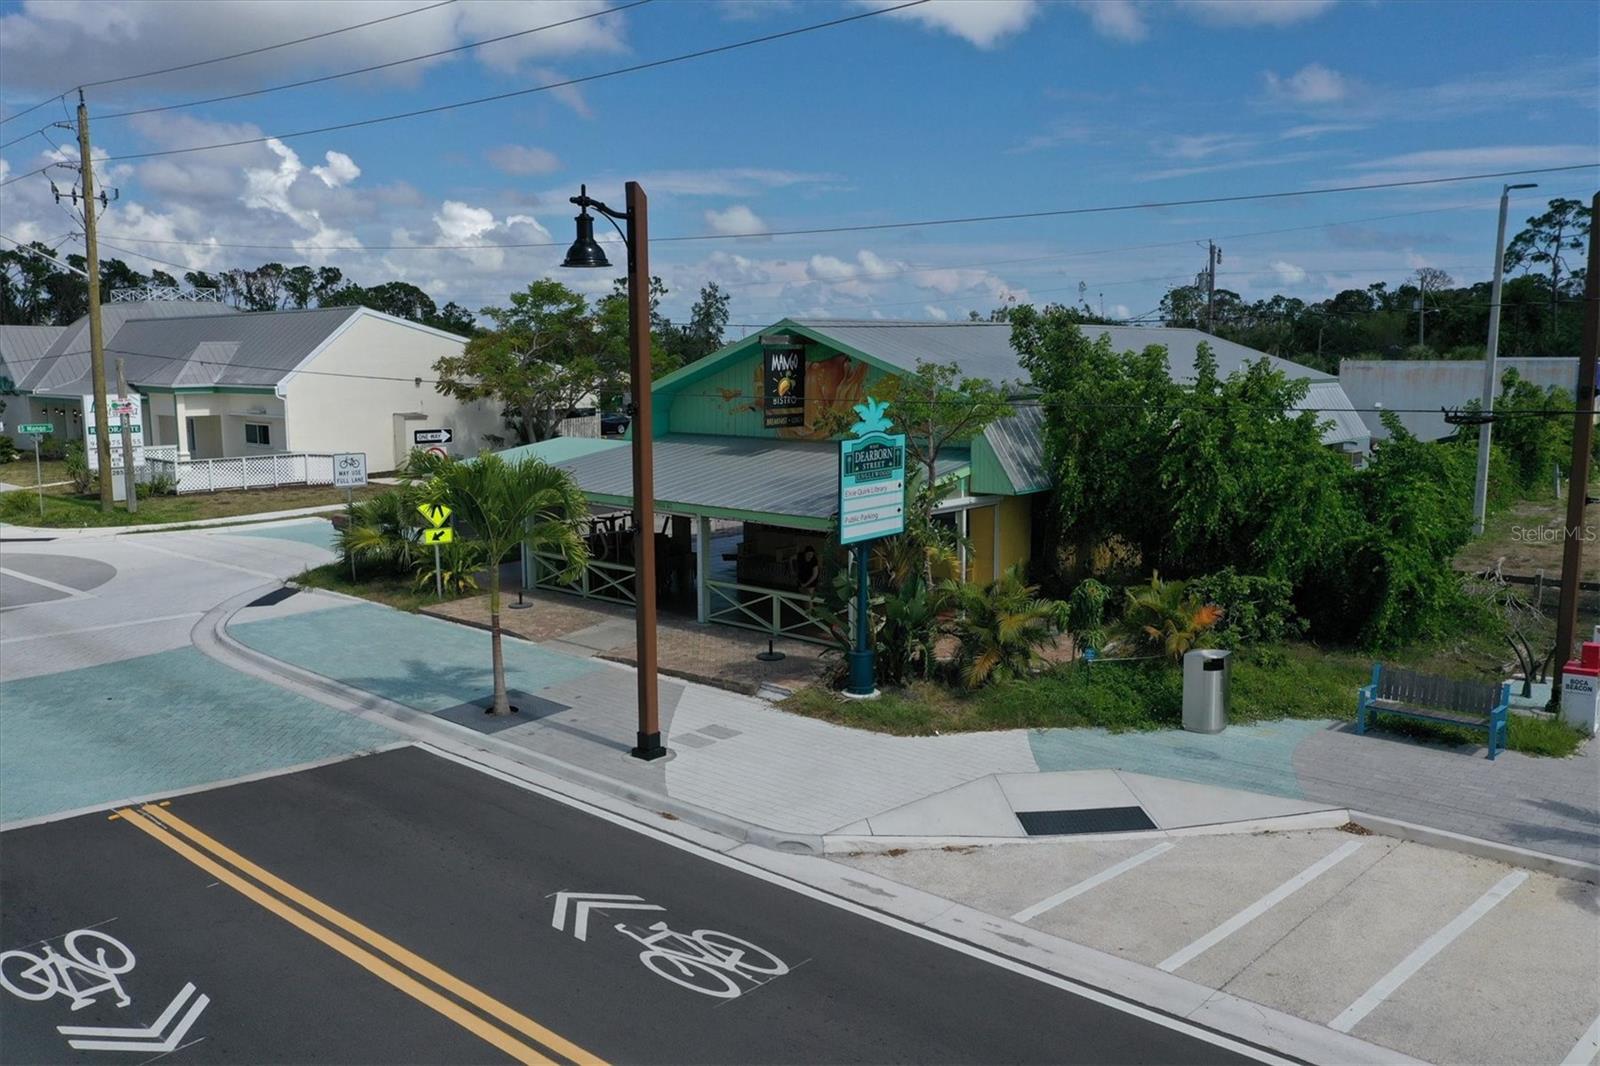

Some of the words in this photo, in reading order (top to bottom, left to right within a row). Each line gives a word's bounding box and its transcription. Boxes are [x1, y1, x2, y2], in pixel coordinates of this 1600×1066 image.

[771, 353, 799, 371] MANGO
[773, 395, 797, 405] BISTRO
[855, 447, 893, 463] DEARBORN
[862, 461, 885, 470] STREET
[861, 512, 880, 521] Parking
[1570, 678, 1588, 686] BOCA
[1565, 683, 1593, 692] BEACON
